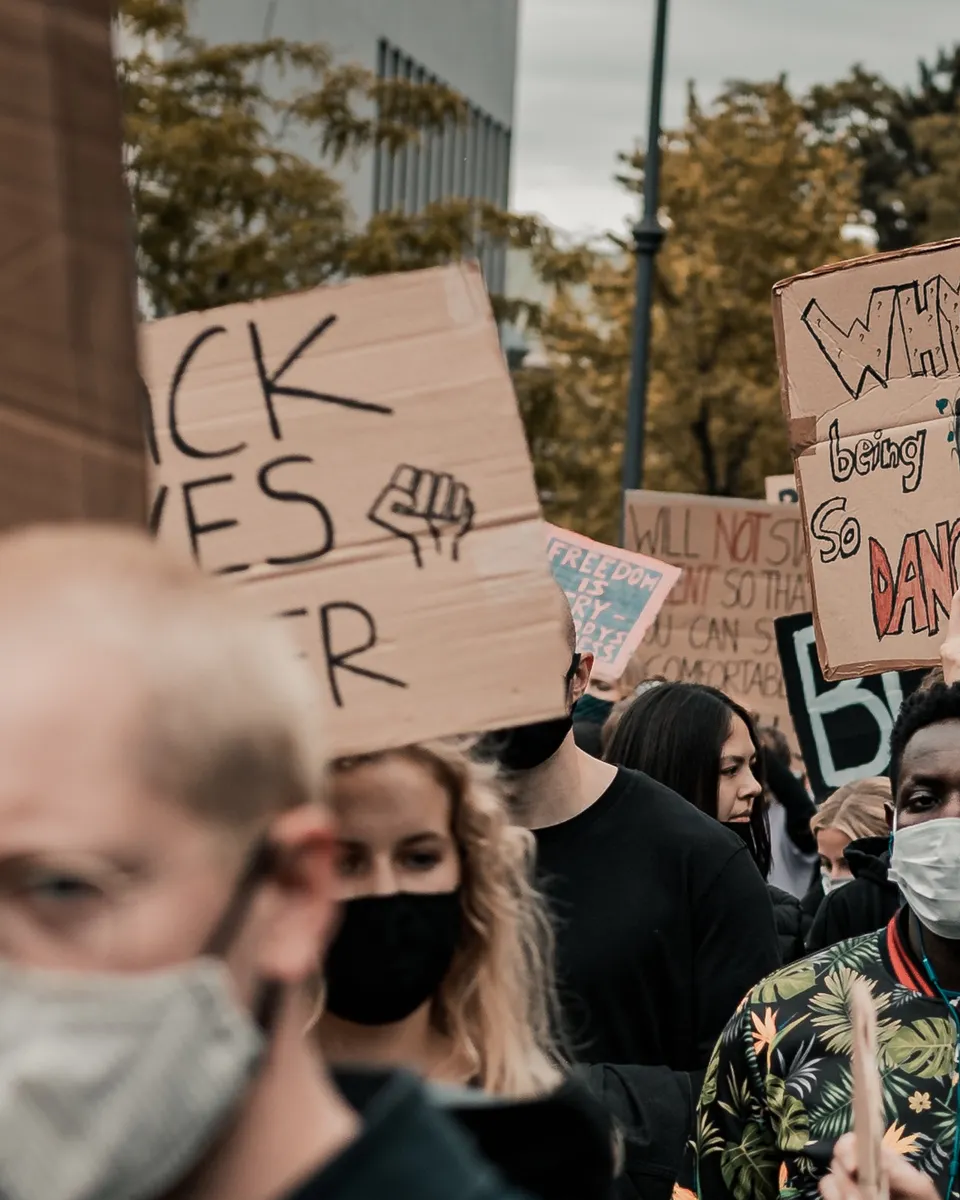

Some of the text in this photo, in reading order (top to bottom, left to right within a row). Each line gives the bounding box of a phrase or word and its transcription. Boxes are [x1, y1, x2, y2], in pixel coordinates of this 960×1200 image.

[829, 419, 927, 494] being
[628, 502, 700, 559] WILL
[712, 509, 771, 566] NOT
[547, 539, 661, 592] FREEDOM
[577, 577, 609, 597] IS
[720, 567, 757, 610] SO
[689, 616, 740, 653] CAN
